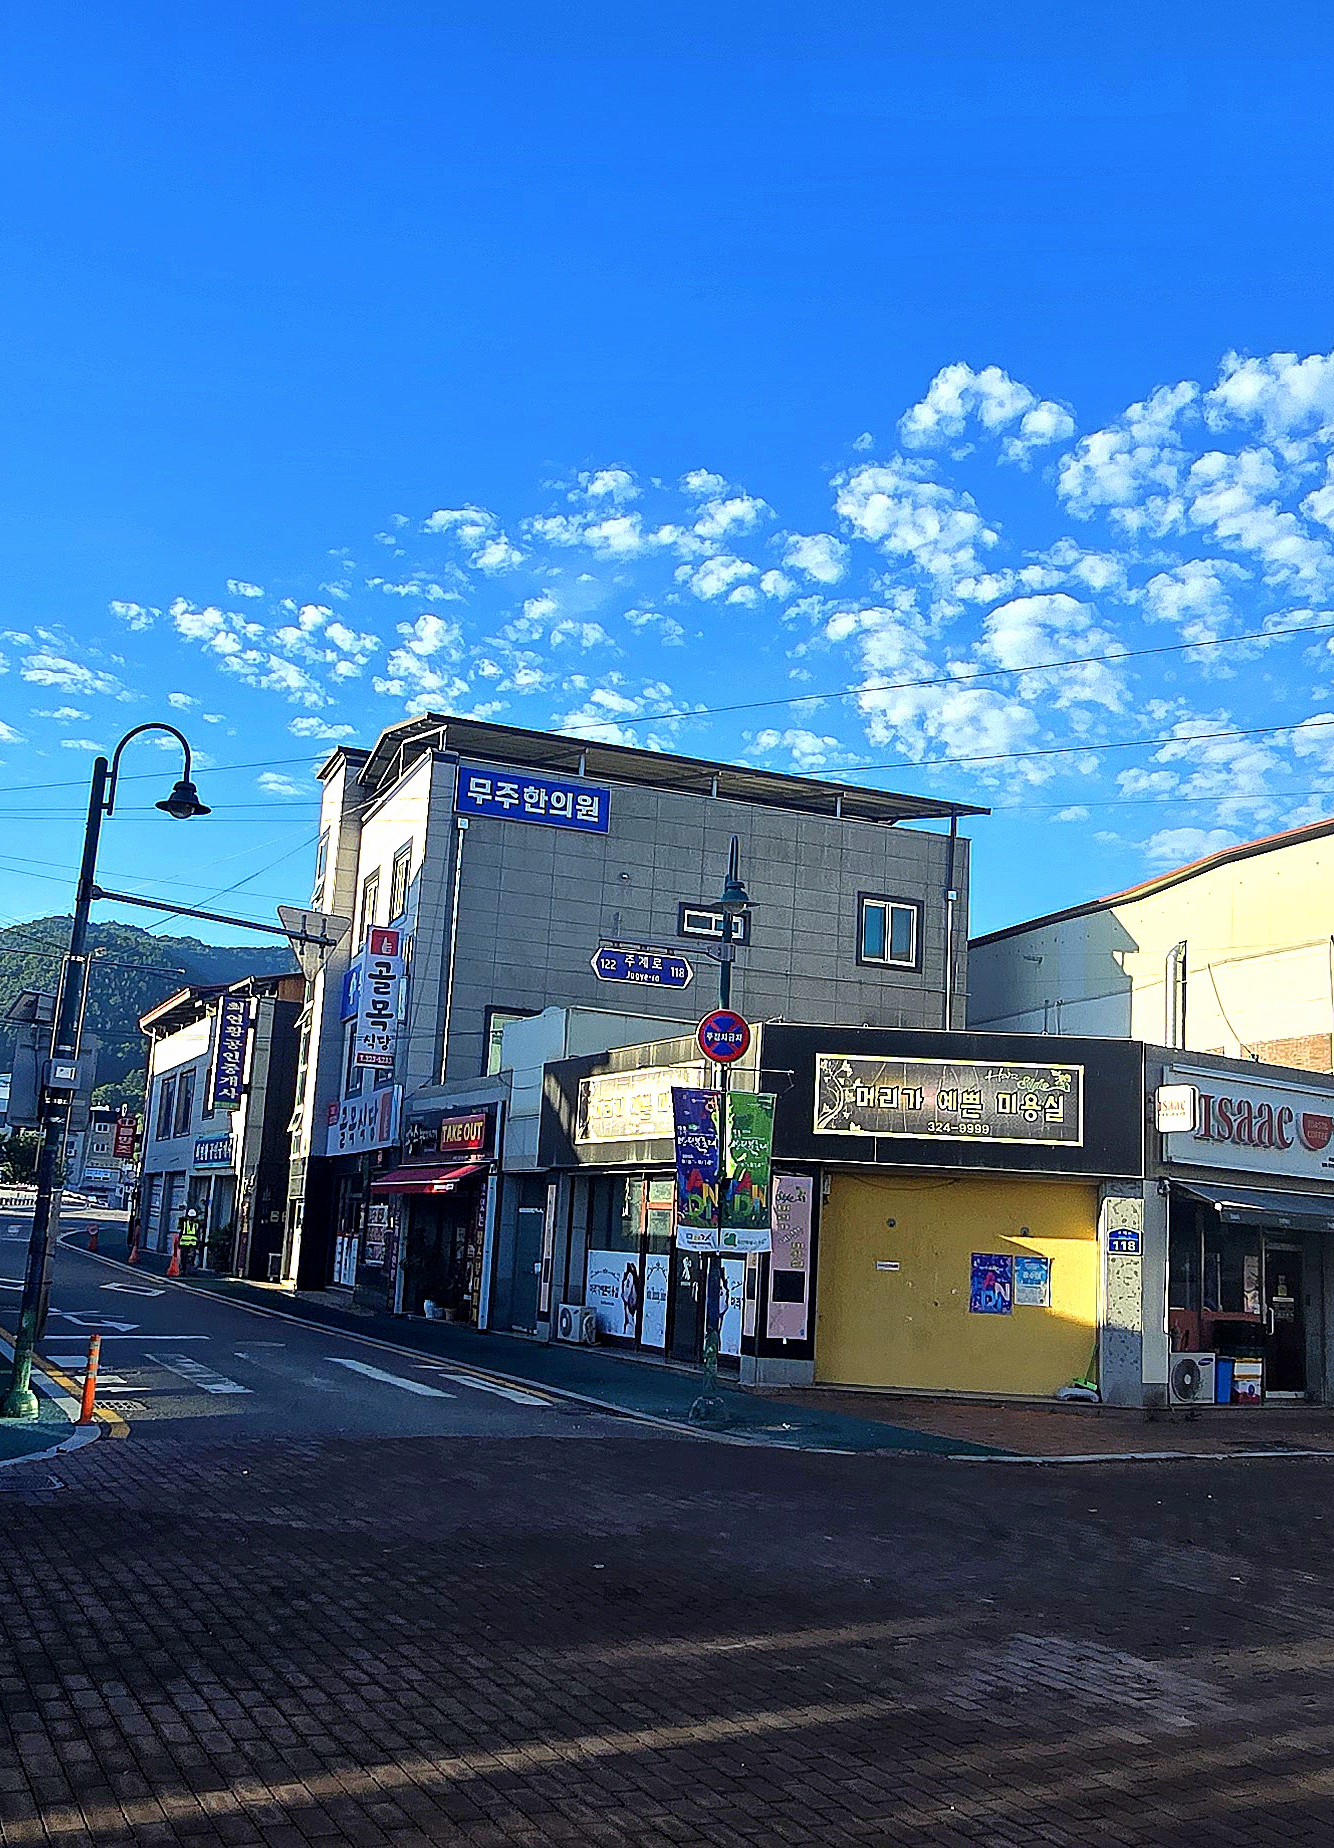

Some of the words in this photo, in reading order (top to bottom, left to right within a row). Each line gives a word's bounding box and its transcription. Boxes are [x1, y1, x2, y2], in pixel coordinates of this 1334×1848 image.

[467, 777, 600, 823] 무주한의원
[599, 958, 617, 970] 122
[624, 954, 663, 970] 주계로
[625, 970, 660, 983] Jugye-ro
[670, 966, 685, 978] 118
[365, 961, 397, 1032] 골목
[363, 1034, 392, 1051] 식당
[856, 1085, 923, 1111] 머리가
[937, 1087, 983, 1119] 예쁜
[995, 1092, 1065, 1124] 미용실
[927, 1121, 990, 1135] 324-9999
[1196, 1093, 1295, 1150] Isaac
[442, 1124, 462, 1143] TAKE
[463, 1121, 483, 1141] OUT
[1112, 1240, 1136, 1251] 118
